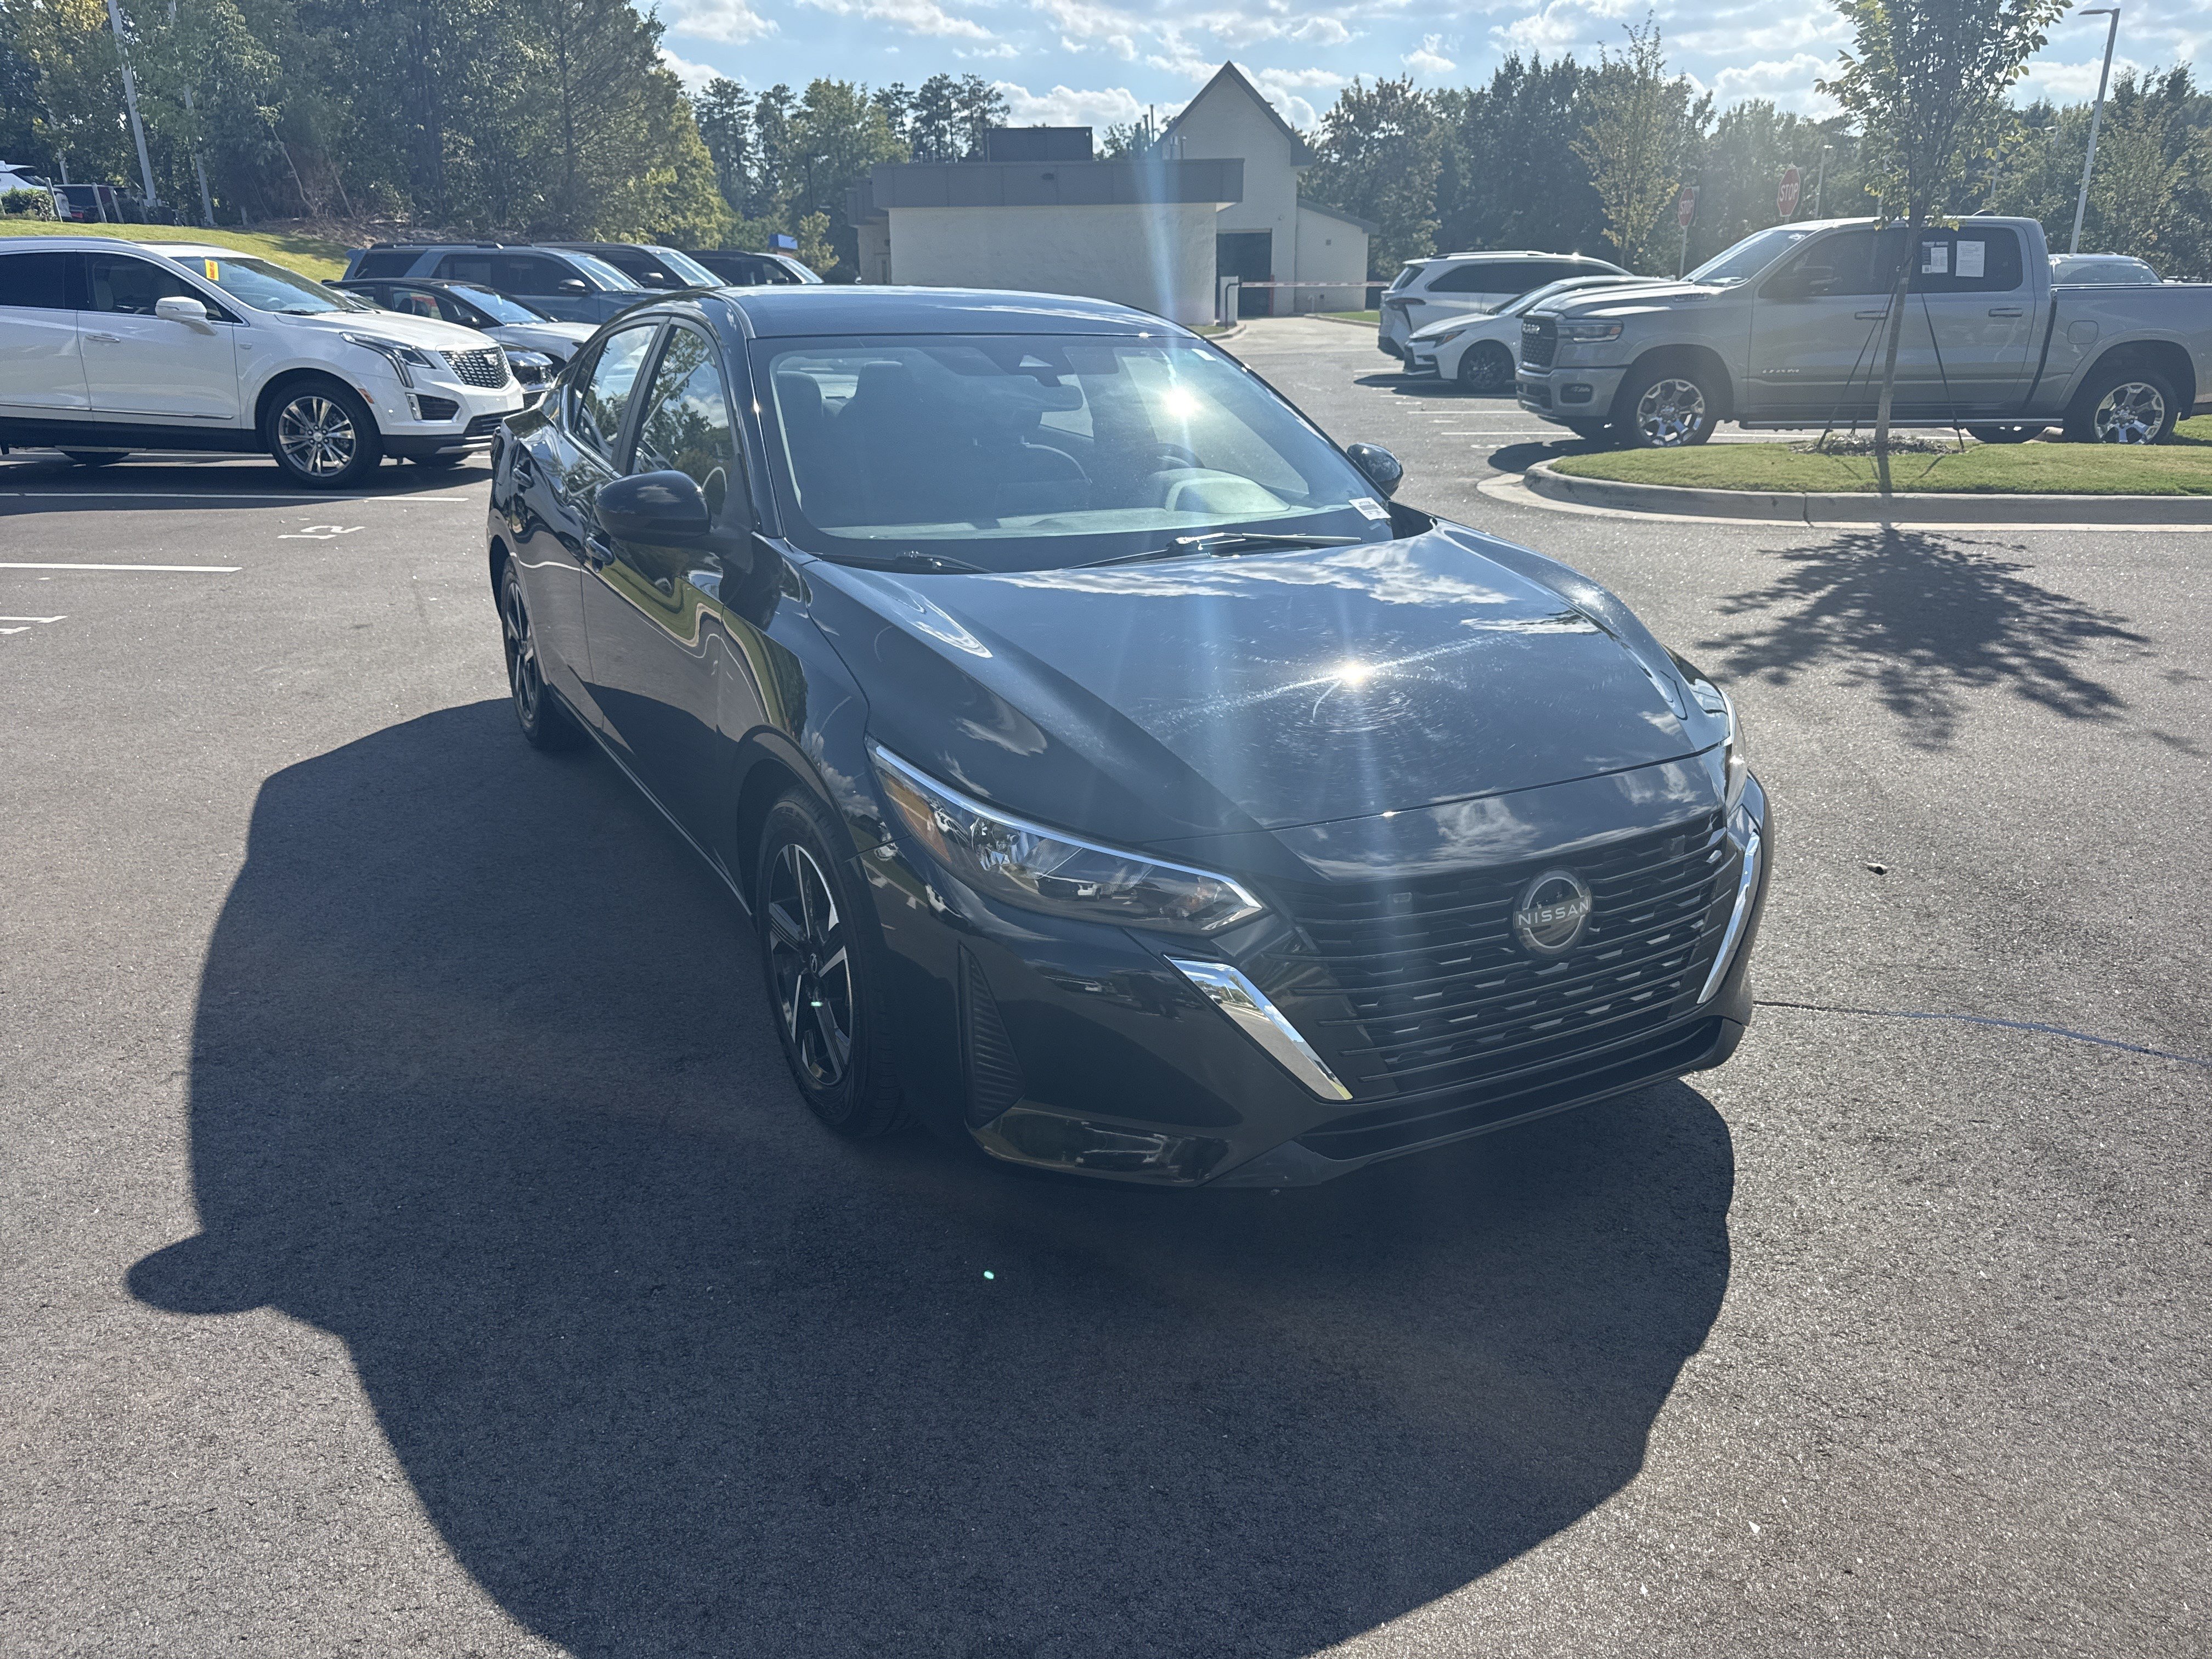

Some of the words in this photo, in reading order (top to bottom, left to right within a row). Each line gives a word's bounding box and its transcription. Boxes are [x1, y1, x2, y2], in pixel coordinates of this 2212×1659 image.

[1780, 183, 1798, 201] STOP
[1680, 199, 1694, 215] STOP
[277, 525, 366, 539] 12
[1518, 899, 1589, 926] NISSAN
